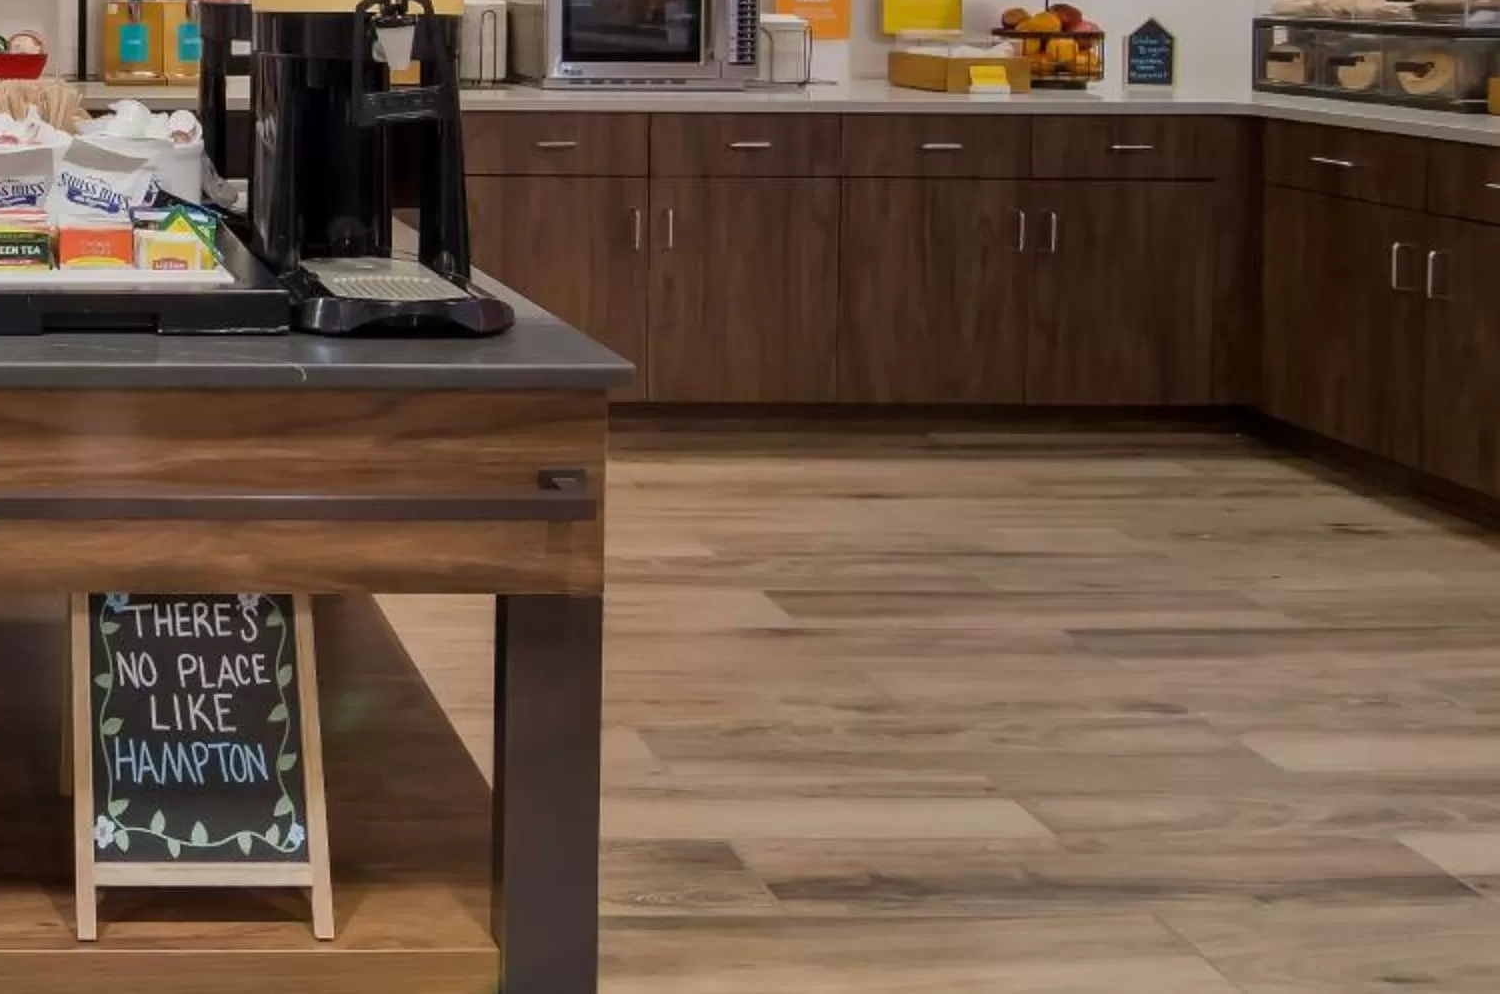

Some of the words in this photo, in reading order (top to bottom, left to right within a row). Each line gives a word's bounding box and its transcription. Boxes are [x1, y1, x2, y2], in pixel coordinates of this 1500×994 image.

[21, 245, 41, 255] TEA
[124, 602, 259, 643] THERE'S
[115, 651, 158, 689] NO
[177, 653, 271, 689] PLACE
[150, 692, 237, 732] LIKE
[115, 736, 269, 786] HAMPTON
